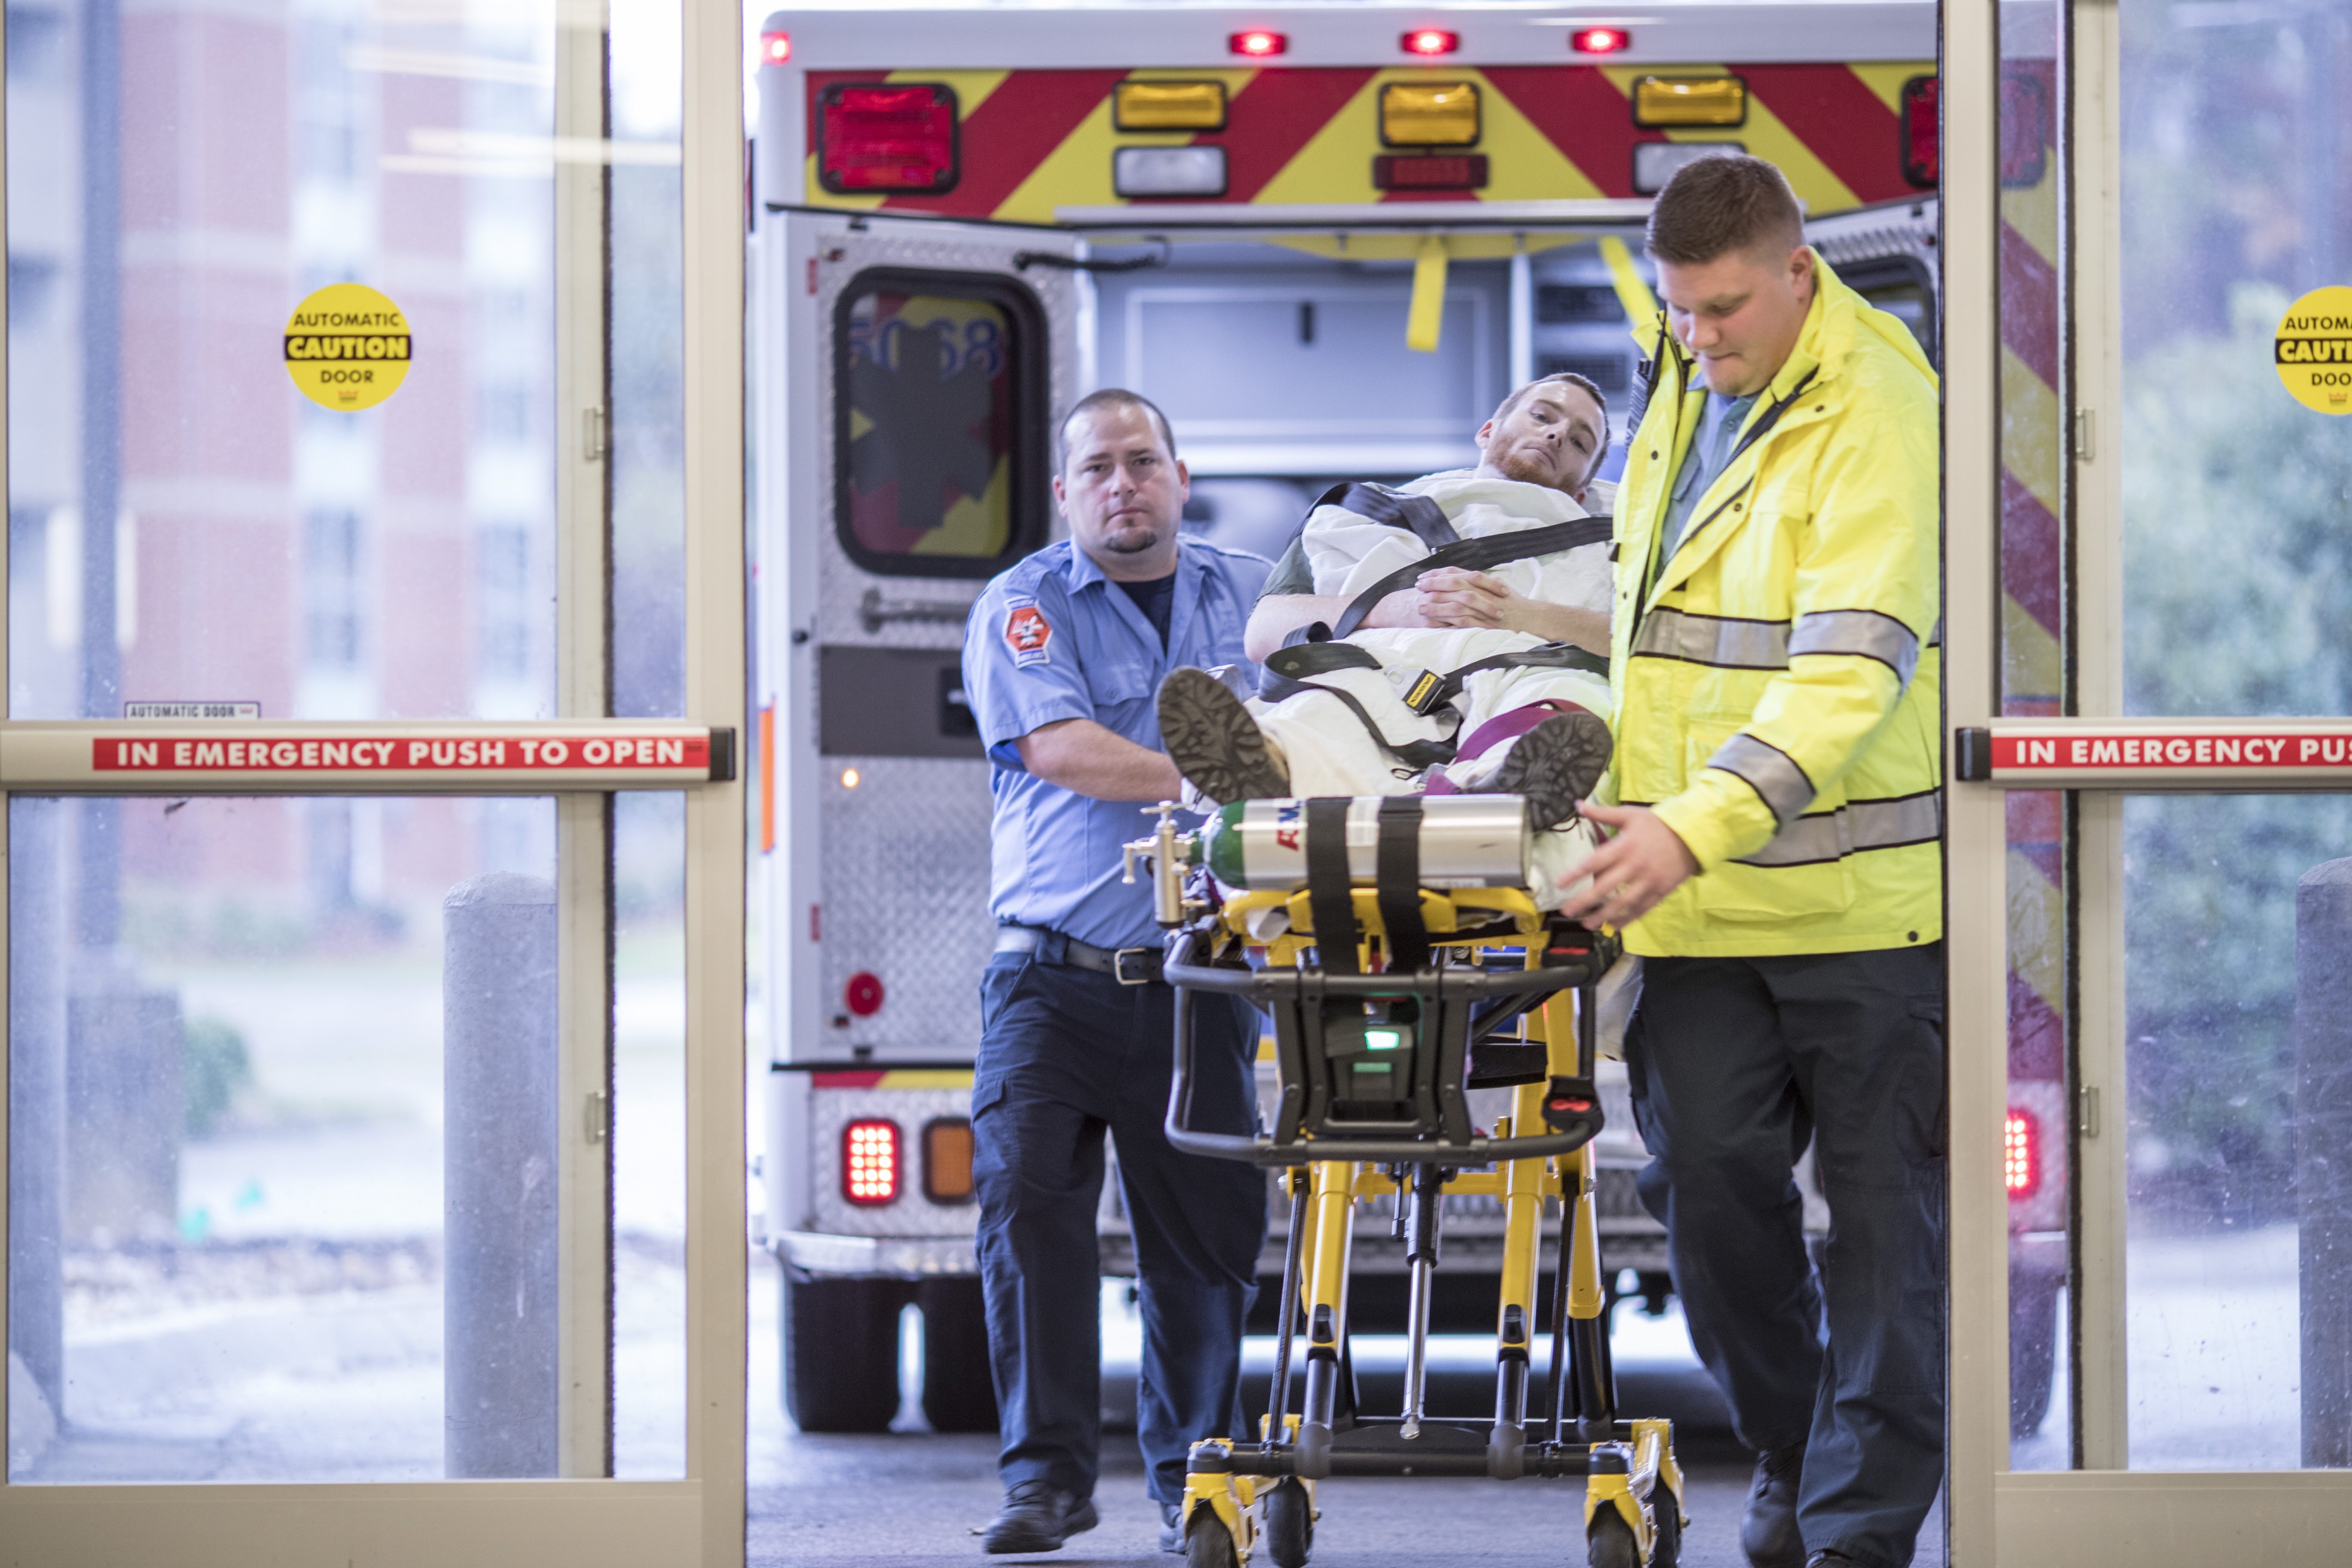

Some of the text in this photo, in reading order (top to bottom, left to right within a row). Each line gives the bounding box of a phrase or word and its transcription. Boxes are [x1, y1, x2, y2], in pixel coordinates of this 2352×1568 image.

[294, 313, 399, 327] AUTOMATIC
[2285, 317, 2352, 330] AUTOM
[287, 336, 408, 359] CAUTION
[320, 370, 374, 383] DOOR
[130, 705, 235, 717] AUTOMATIC DOOR
[118, 739, 683, 766] IN EMERGENCY PUSH TO OPEN
[2016, 738, 2352, 764] IN EMERGENCY PU
